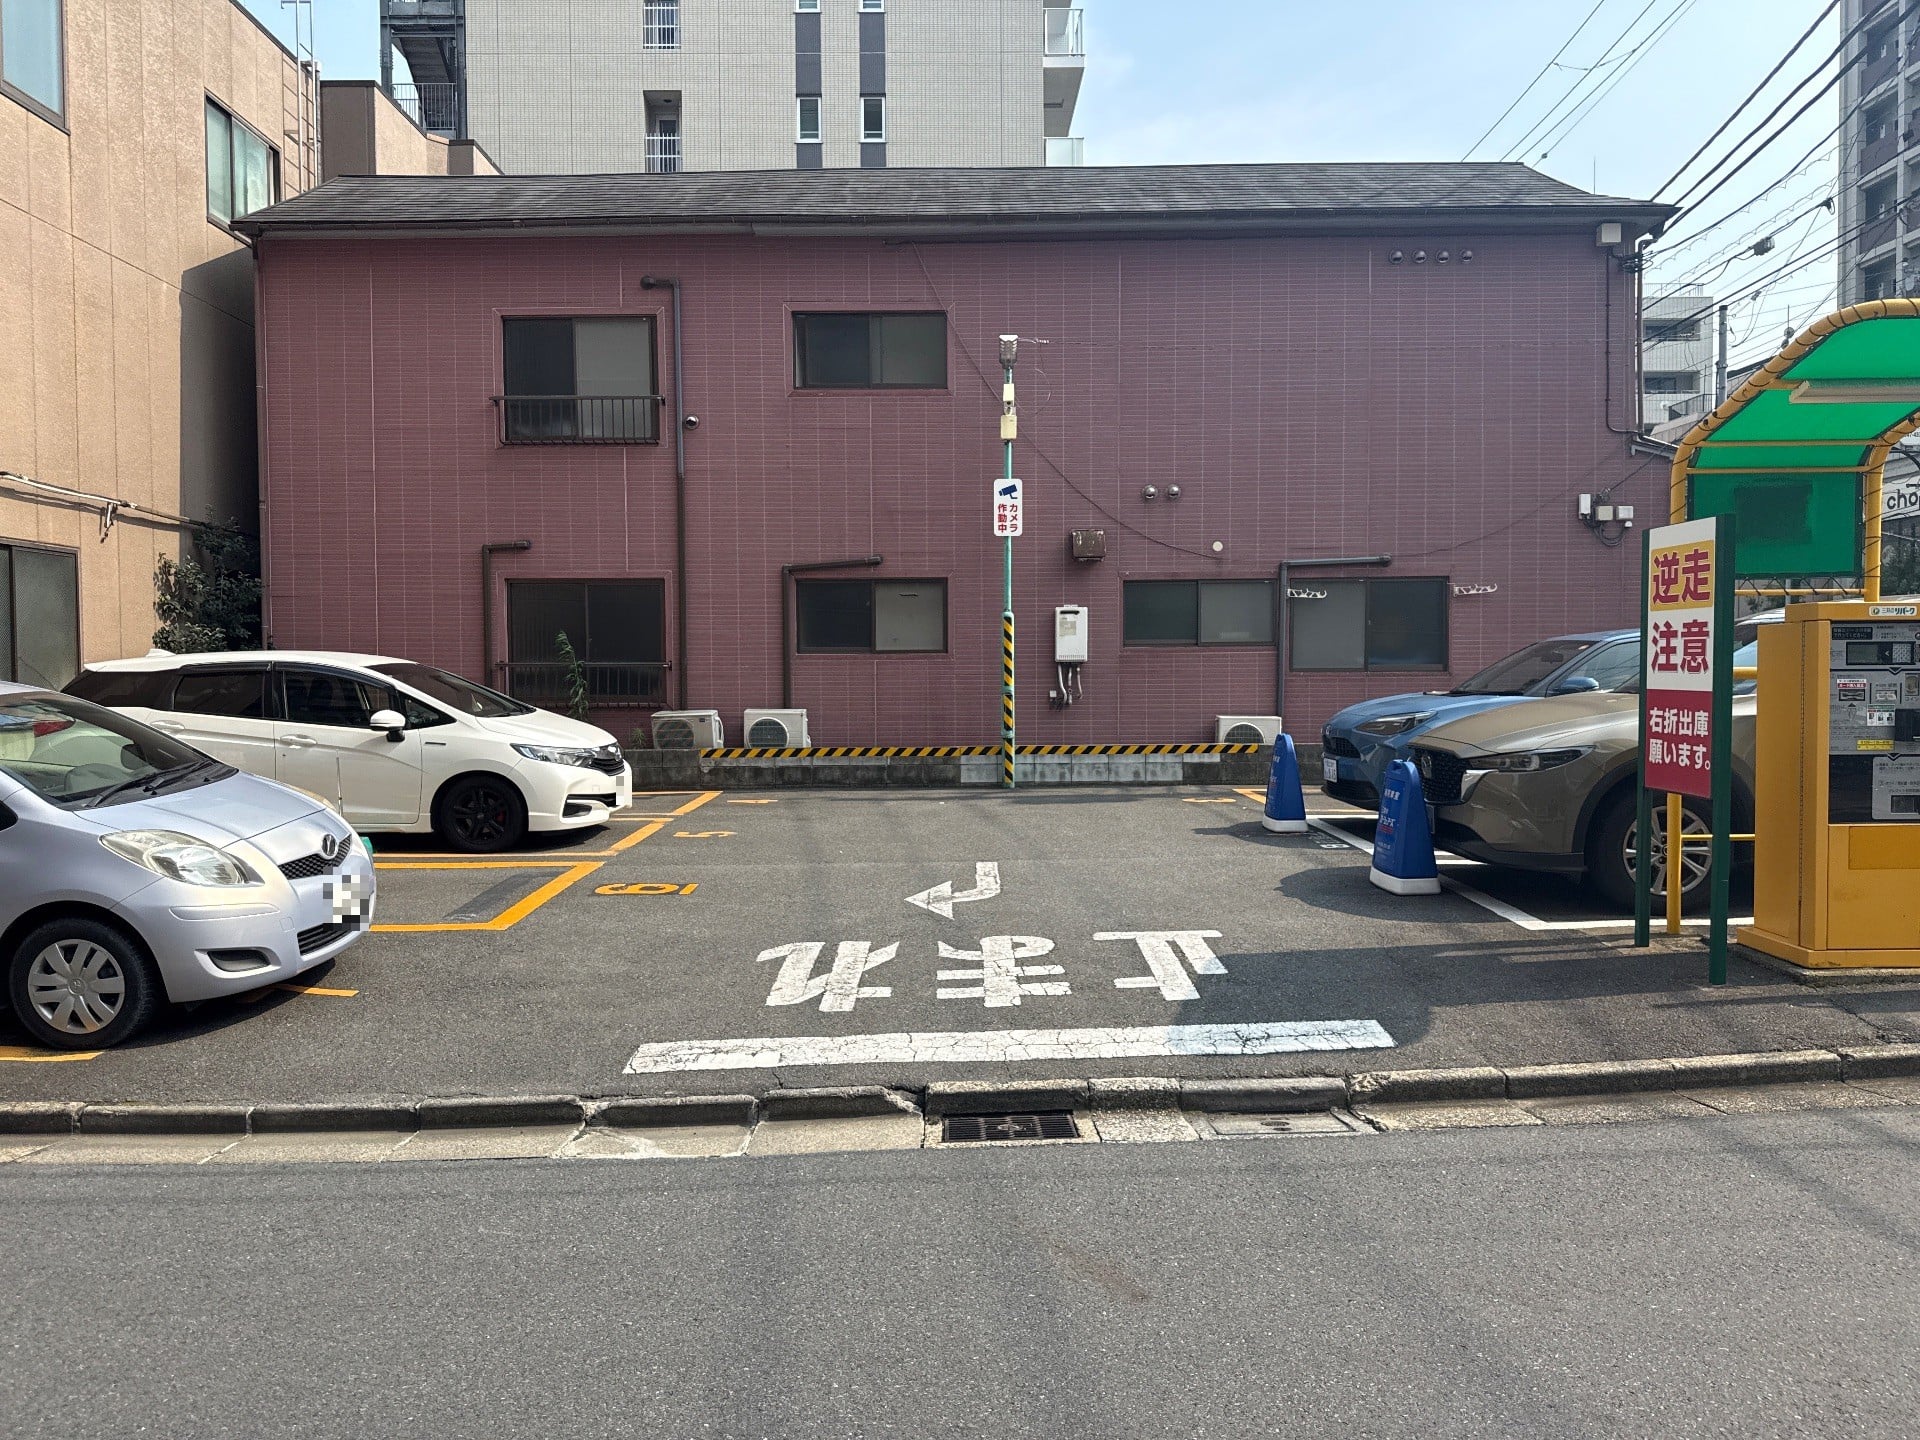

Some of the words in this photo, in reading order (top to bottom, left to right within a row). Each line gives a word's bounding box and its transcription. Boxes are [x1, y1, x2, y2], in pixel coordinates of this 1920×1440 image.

[1887, 489, 1920, 510] cho
[998, 504, 1007, 532] 作動中
[1009, 504, 1018, 532] カメラ
[1652, 549, 1711, 604] 逆走
[1650, 618, 1710, 673] 注意
[1649, 706, 1709, 737] 右折出庫
[1648, 737, 1711, 771] 願います。
[673, 830, 737, 838] 5
[756, 930, 1228, 1012] 止まれ
